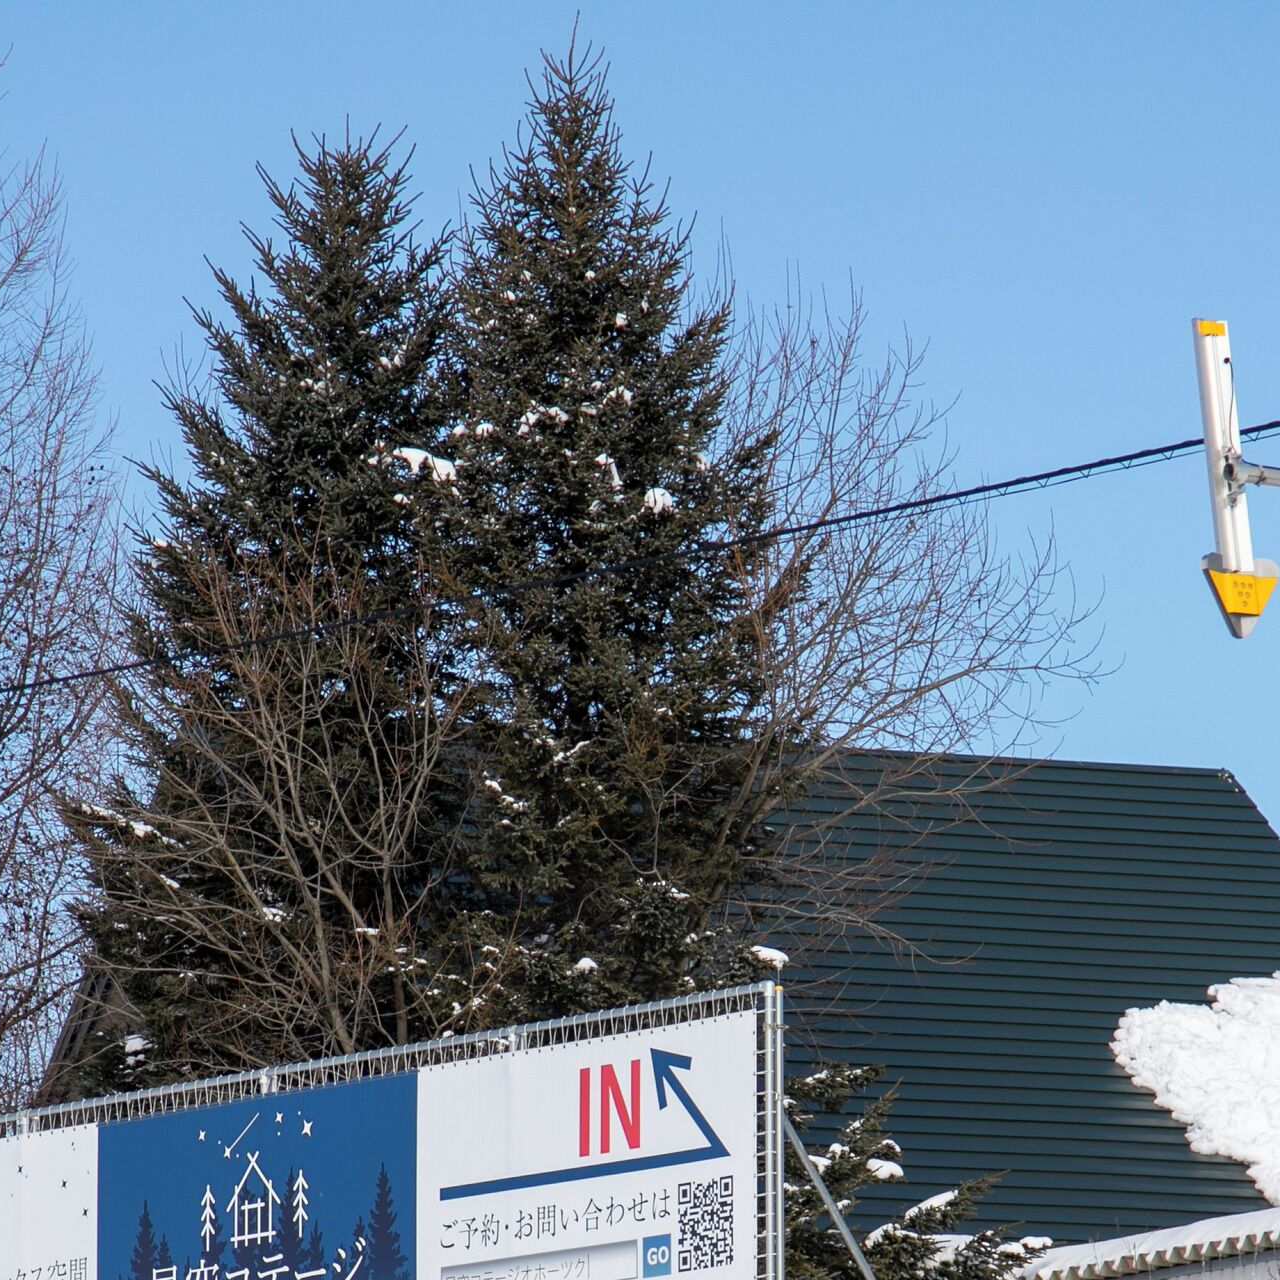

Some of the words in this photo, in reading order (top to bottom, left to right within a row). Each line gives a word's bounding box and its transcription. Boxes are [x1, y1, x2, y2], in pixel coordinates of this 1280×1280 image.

[579, 1059, 641, 1157] IN
[439, 1188, 671, 1250] ご予約・お問い合わせは
[646, 1245, 670, 1266] GO
